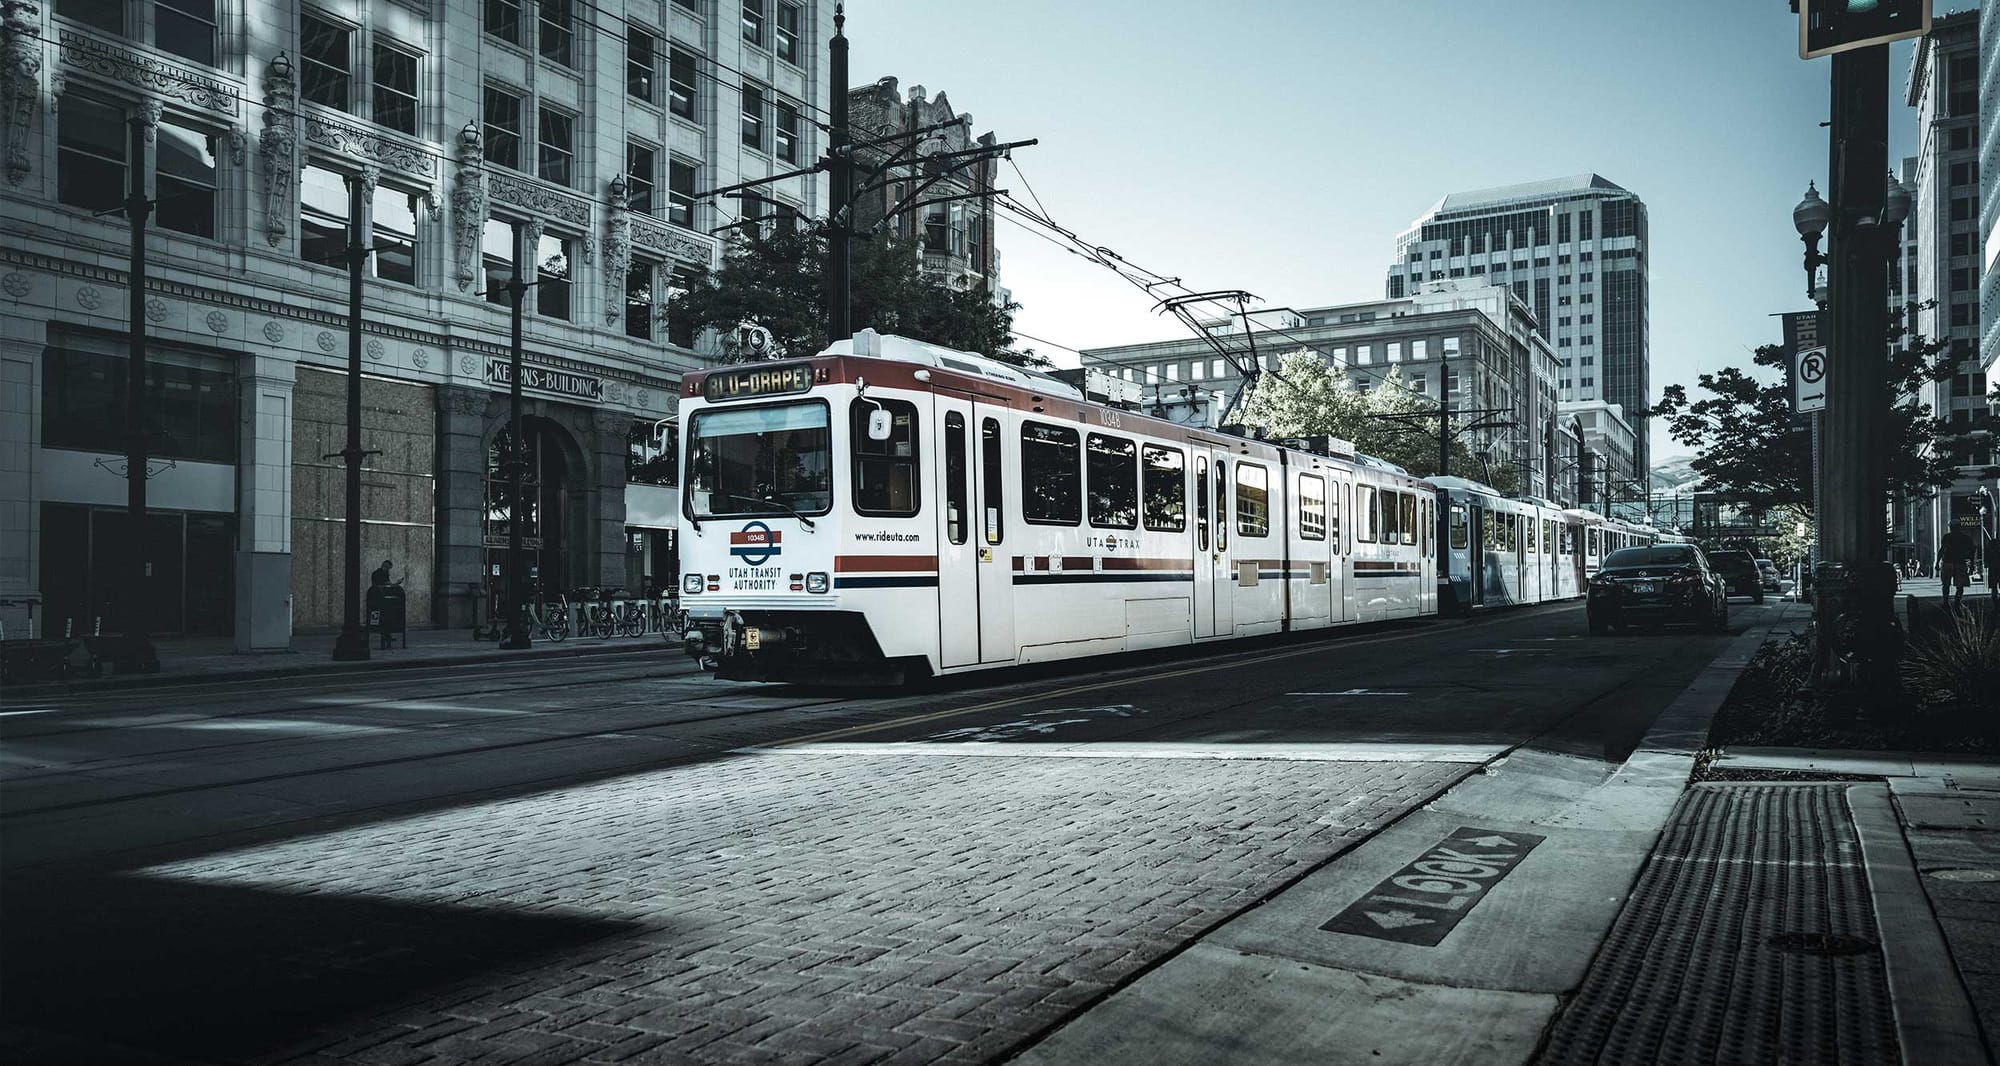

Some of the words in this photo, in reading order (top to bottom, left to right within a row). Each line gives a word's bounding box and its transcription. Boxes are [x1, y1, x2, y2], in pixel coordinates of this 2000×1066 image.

[1099, 408, 1121, 428] 1034B
[747, 534, 765, 542] 1034B
[855, 530, 920, 542] www.rideuta.com
[1086, 536, 1104, 548] UTA
[1119, 538, 1140, 549] TRAX
[729, 567, 748, 578] UTAH
[751, 567, 782, 578] TRANSIT
[734, 579, 776, 590] AUTHORITY
